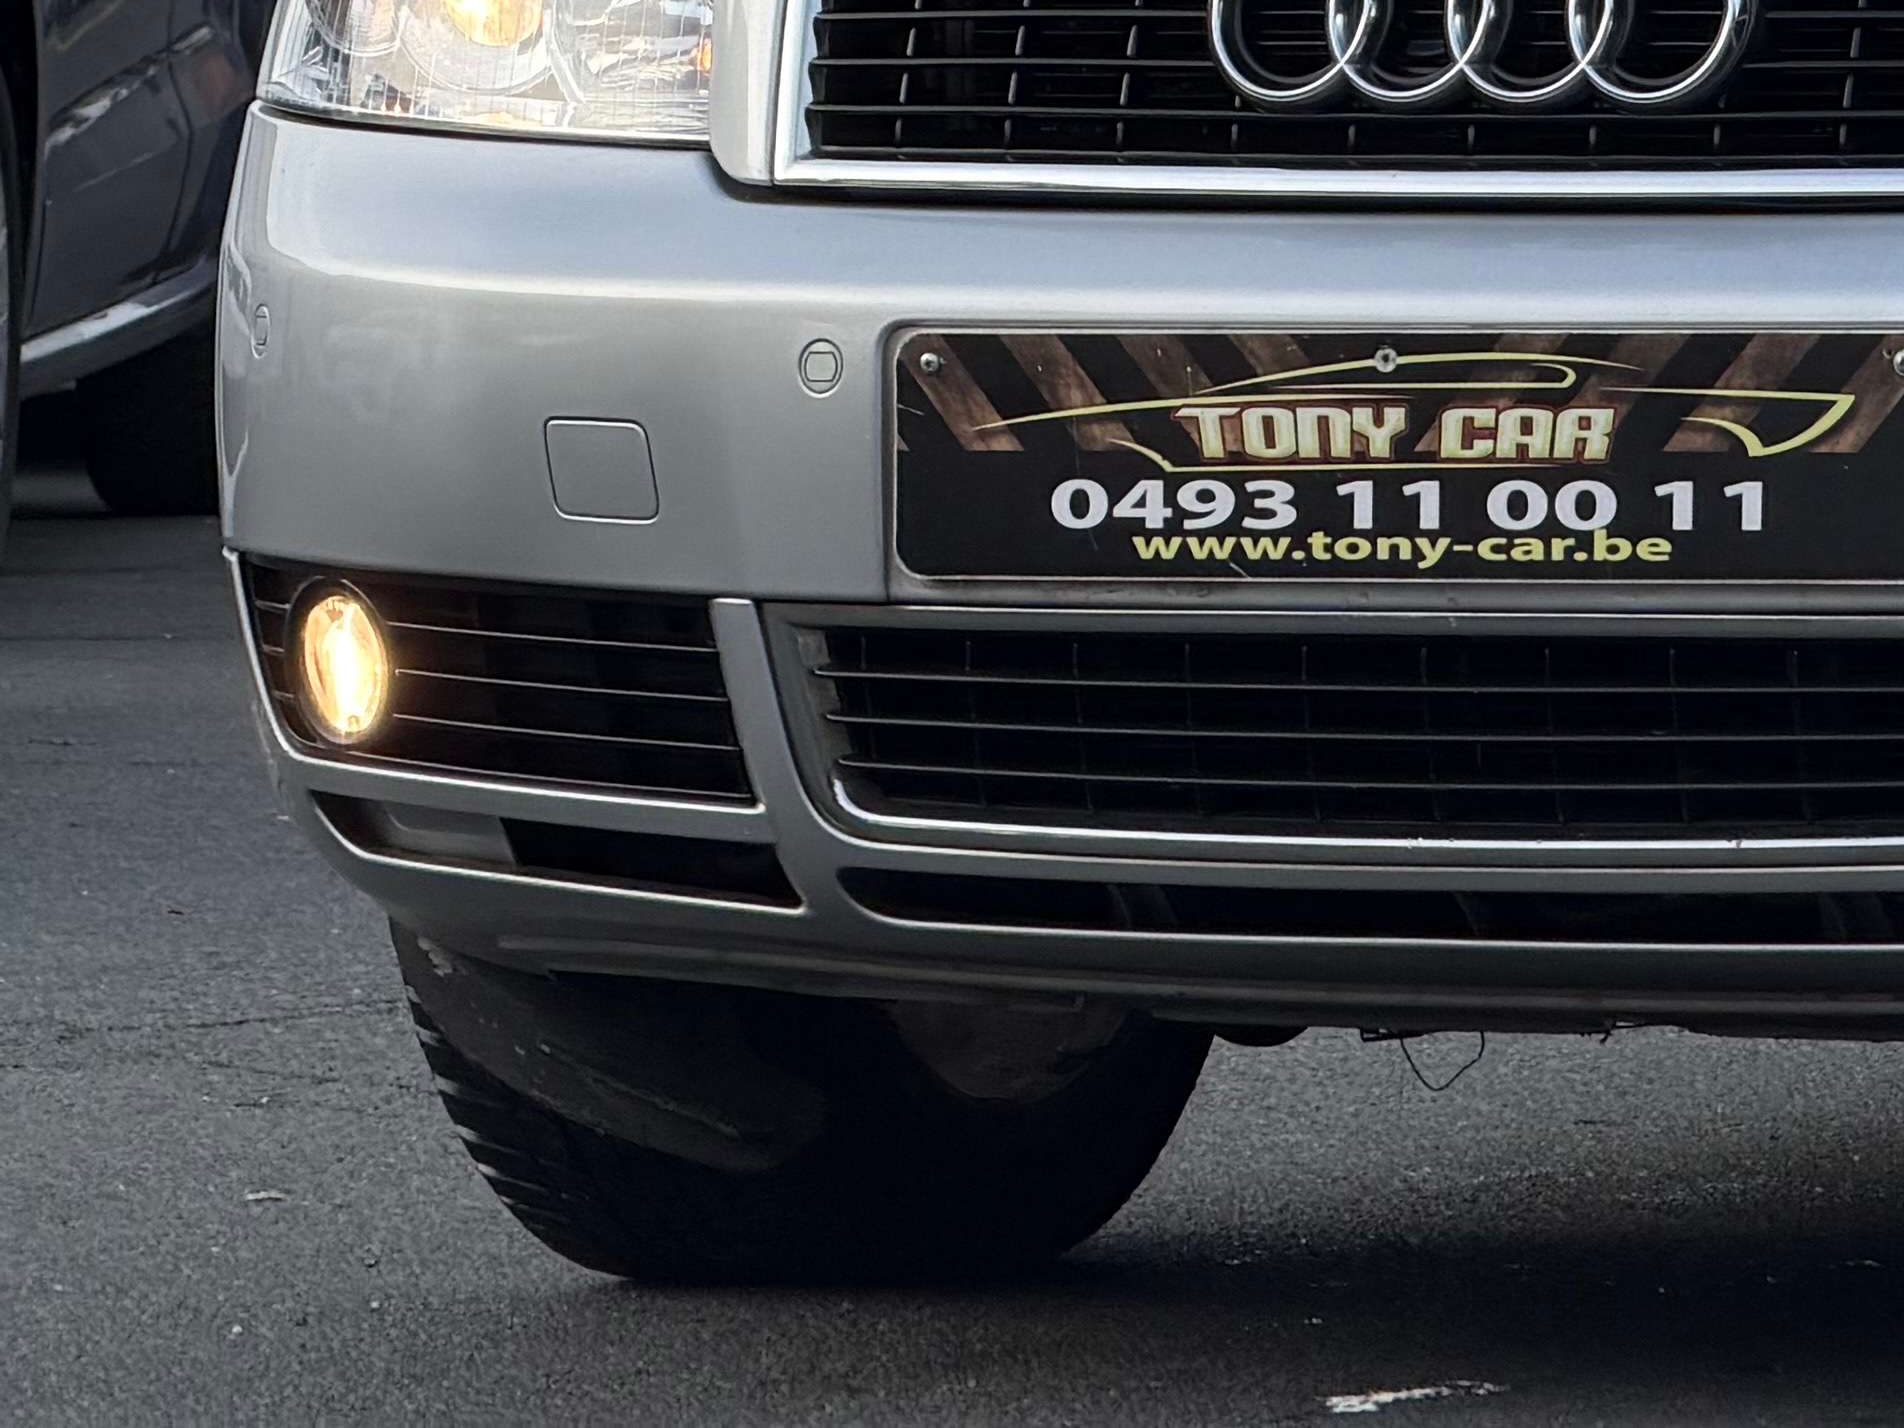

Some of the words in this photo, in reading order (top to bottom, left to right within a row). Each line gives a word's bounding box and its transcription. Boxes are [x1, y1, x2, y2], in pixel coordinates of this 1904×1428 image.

[1173, 405, 1407, 460] TONY
[1439, 406, 1616, 460] CAR
[1050, 478, 1298, 530] 0493
[1336, 479, 1440, 530] 11
[1486, 479, 1618, 531] 00
[1654, 480, 1763, 531] 11
[1131, 529, 1673, 569] www.tony-car.be
